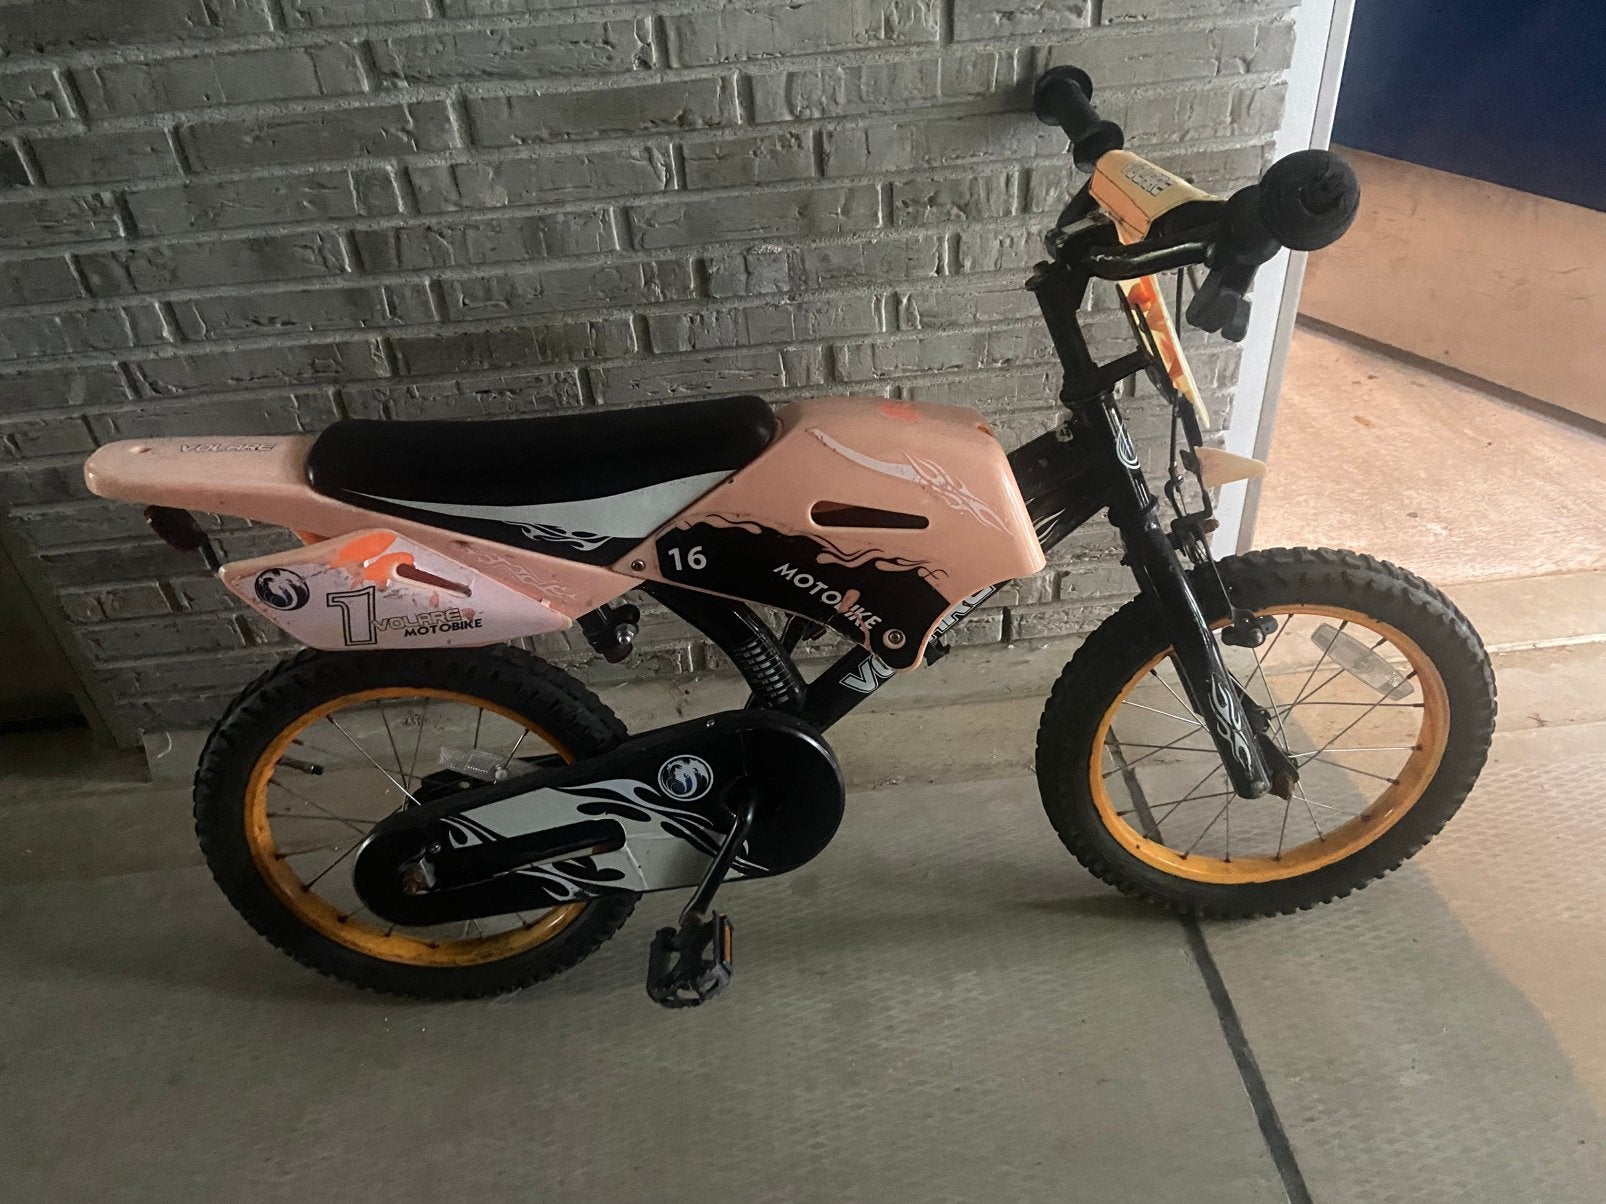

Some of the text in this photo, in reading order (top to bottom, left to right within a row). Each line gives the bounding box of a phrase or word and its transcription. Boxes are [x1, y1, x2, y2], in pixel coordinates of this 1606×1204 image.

[667, 545, 708, 572] 16
[772, 562, 883, 632] MOTOIKE
[326, 585, 378, 647] 1
[371, 607, 463, 632] VOLARE
[403, 618, 484, 638] MOTOBIKE
